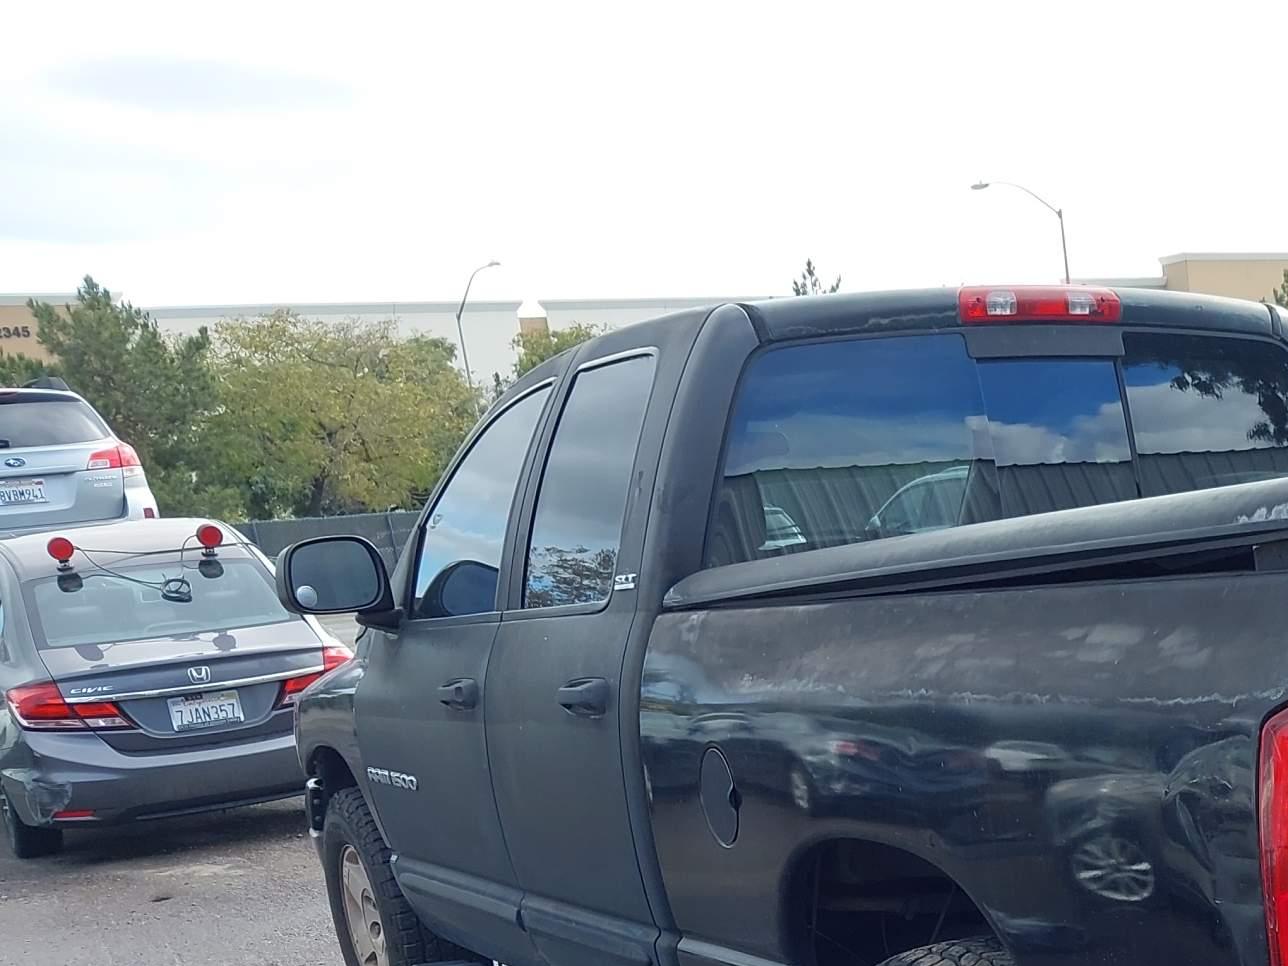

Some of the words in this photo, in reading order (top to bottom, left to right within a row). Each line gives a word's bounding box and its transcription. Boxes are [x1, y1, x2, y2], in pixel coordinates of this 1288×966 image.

[0, 326, 30, 338] 345
[70, 685, 113, 694] CIVIC
[175, 702, 237, 726] 7JAN357
